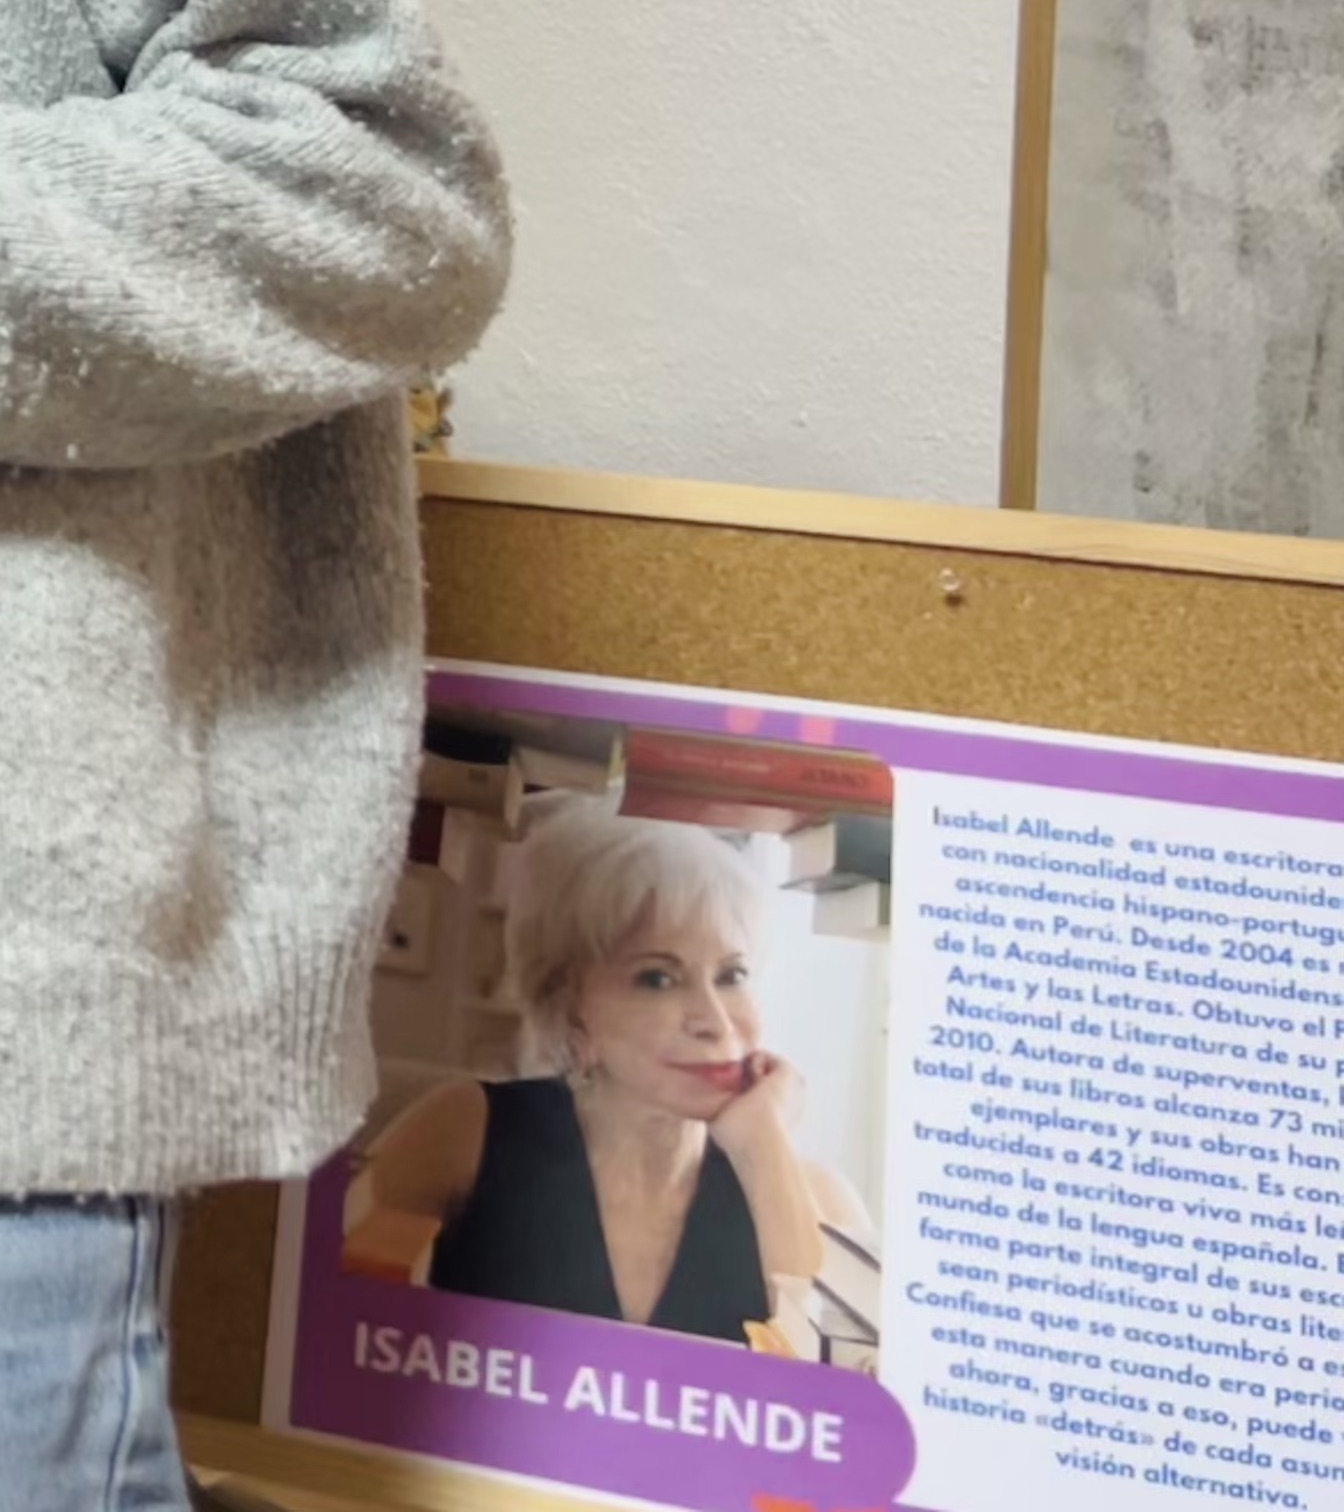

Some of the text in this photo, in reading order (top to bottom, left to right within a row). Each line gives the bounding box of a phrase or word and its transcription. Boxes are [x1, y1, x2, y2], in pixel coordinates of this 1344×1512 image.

[932, 805, 1008, 834] Isabel
[1014, 816, 1114, 848] Allende
[1128, 838, 1157, 854] es
[1163, 842, 1215, 862] una
[941, 844, 1344, 910] con nacionalidad estadounide
[954, 877, 1115, 911] ascendencia
[918, 903, 1330, 973] nacida en Perú. Desde 2004 es
[933, 930, 1344, 1007] de la Academia Estadounidens
[945, 995, 1327, 1070] Nacional de Literatura de su
[946, 964, 1326, 1038] Artes y las Letras. Obtuvo el
[912, 1056, 1303, 1133] total de sus libros alcanza 73
[929, 1024, 1330, 1108] 2010. Autora de superventas,
[913, 1121, 1285, 1197] traducidas a 42 idiomas. Es
[970, 1097, 1340, 1172] ejemplares y sus obras han
[917, 1191, 1327, 1271] mundo de la lengua española.
[942, 1162, 1307, 1234] como la escritora viva más
[919, 1216, 1291, 1299] forma parte integral de sus
[905, 1281, 1314, 1372] Confiesa que se acostumbró a
[937, 1260, 1291, 1334] sean periodísticos u obras
[354, 1321, 845, 1463] ISABEL ALLENDE
[930, 1326, 1266, 1398] esta manera cuando era
[922, 1384, 1025, 1424] historia
[1162, 1429, 1197, 1455] de
[1204, 1442, 1272, 1468] cada
[948, 1358, 1333, 1444] ahora, gracias a eso, puede
[1054, 1447, 1312, 1509] visión alternativa.
